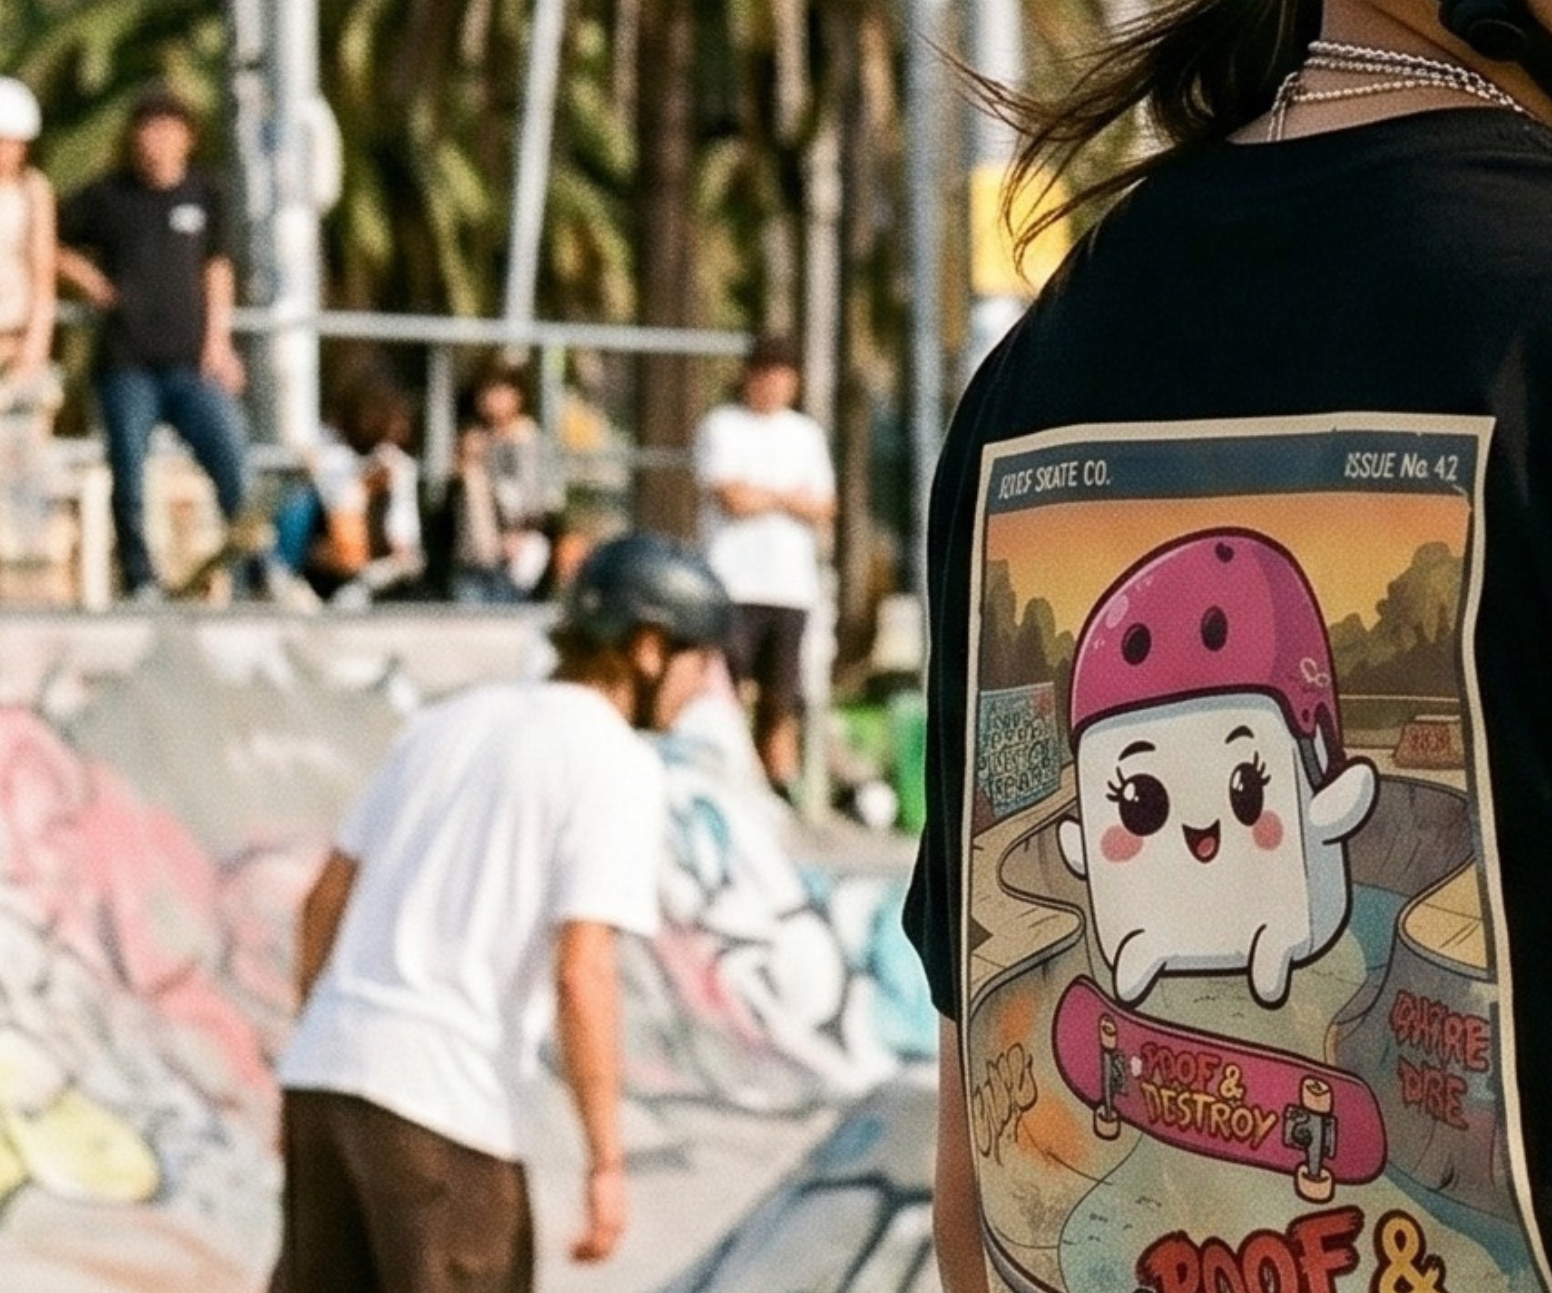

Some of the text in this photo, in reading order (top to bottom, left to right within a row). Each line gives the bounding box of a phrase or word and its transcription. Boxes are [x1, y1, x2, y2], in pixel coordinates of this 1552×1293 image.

[1083, 459, 1112, 486] CO.
[1343, 451, 1397, 479] ISSUE
[1433, 454, 1460, 482] 42
[1218, 1062, 1247, 1102] &
[1140, 1081, 1279, 1150] DESTROY
